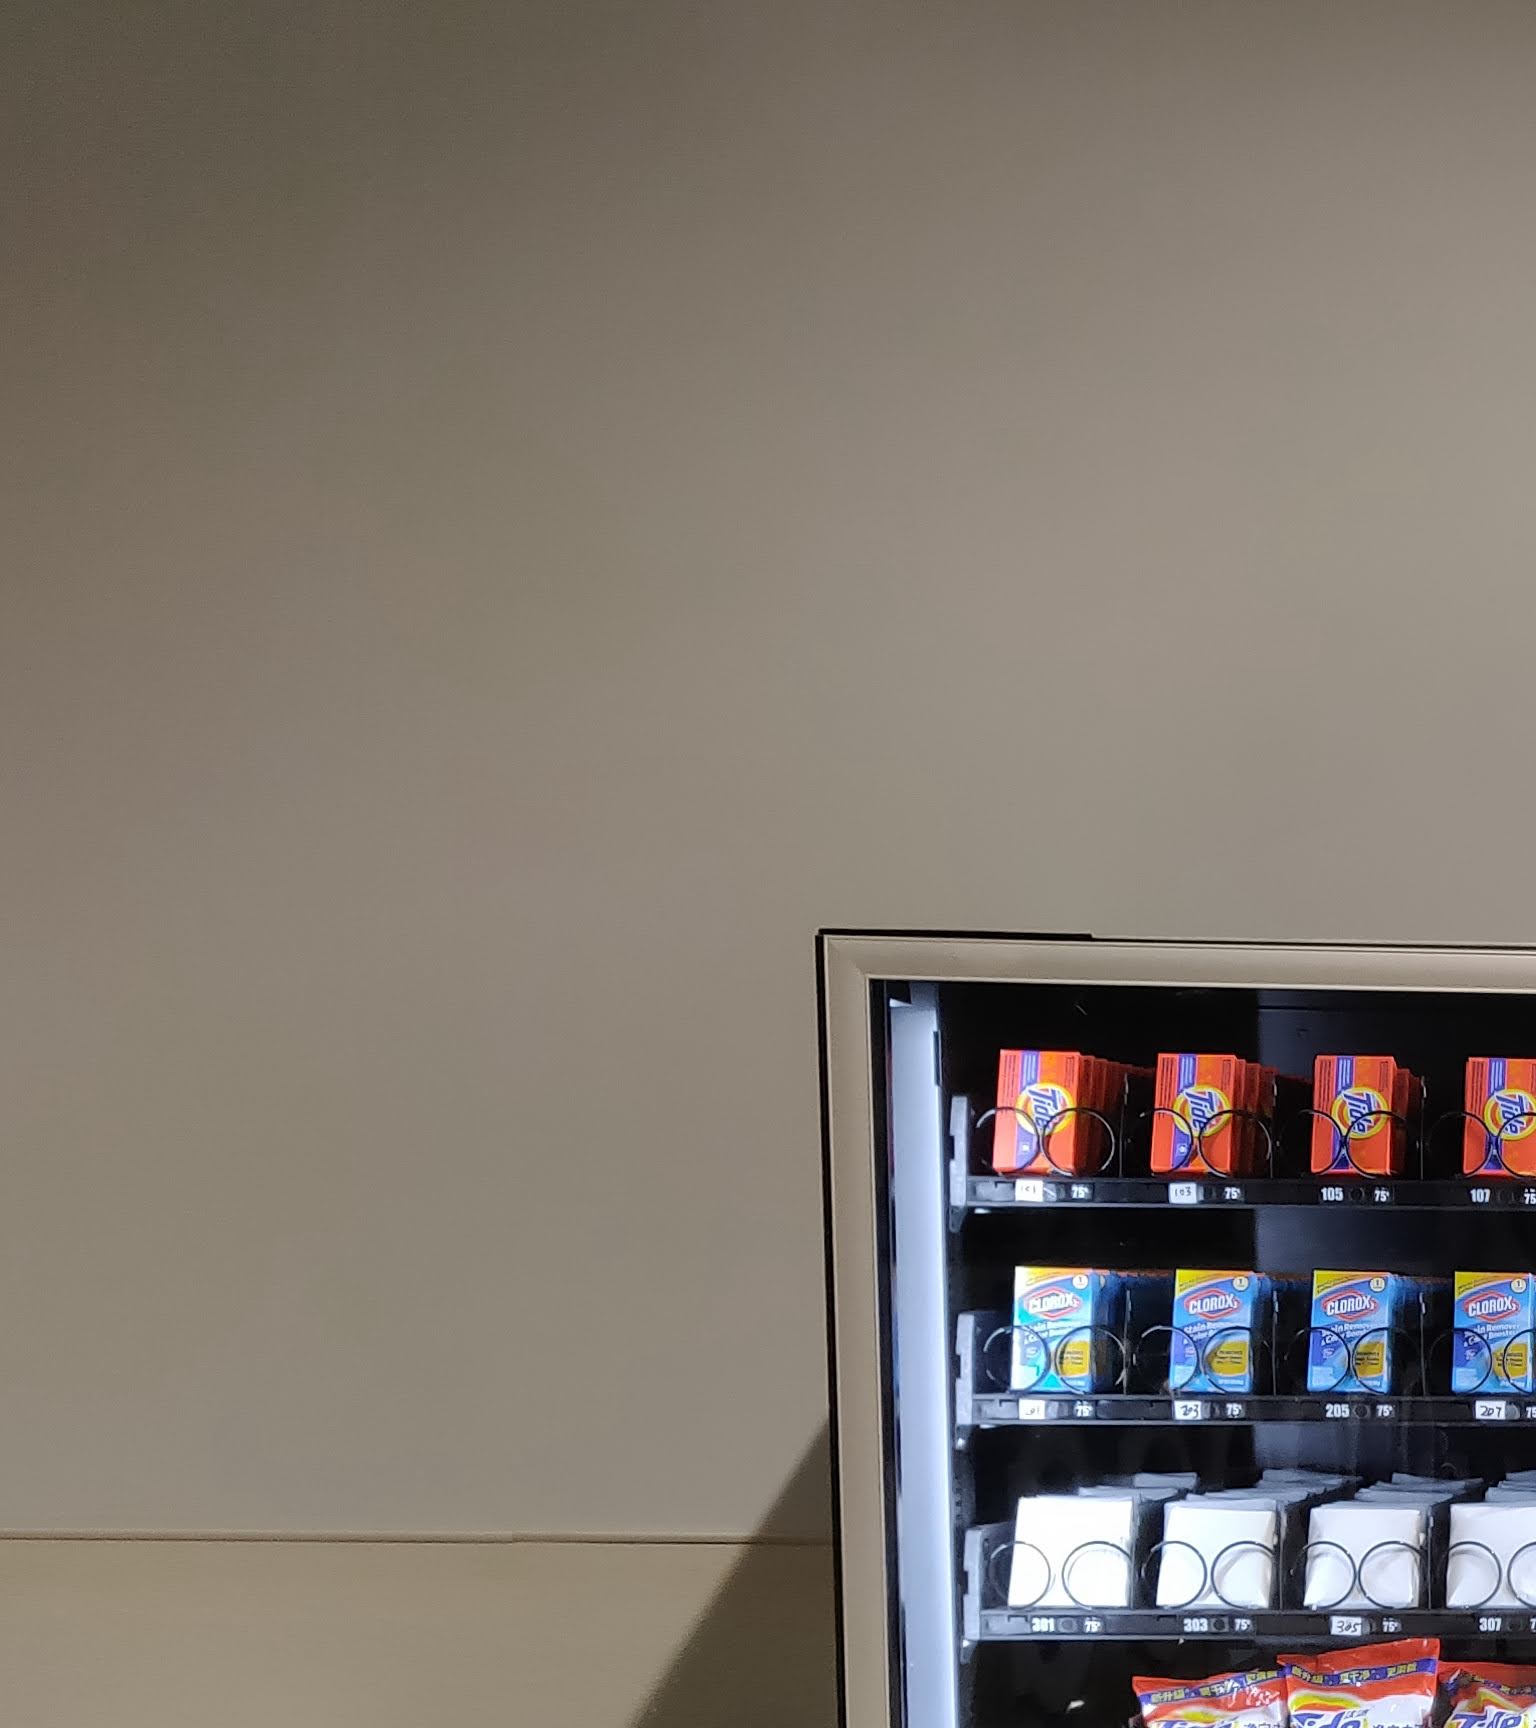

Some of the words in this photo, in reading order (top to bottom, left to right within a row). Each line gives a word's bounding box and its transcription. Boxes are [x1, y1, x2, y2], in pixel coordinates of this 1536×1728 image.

[1028, 1089, 1063, 1130] Tide
[1183, 1092, 1217, 1133] Tide
[1345, 1093, 1377, 1135] Tide
[1495, 1092, 1529, 1135] Tide
[1470, 1188, 1491, 1203] 107
[1325, 1403, 1350, 1418] 205
[1480, 1405, 1503, 1417] 207
[1479, 1617, 1502, 1632] 307
